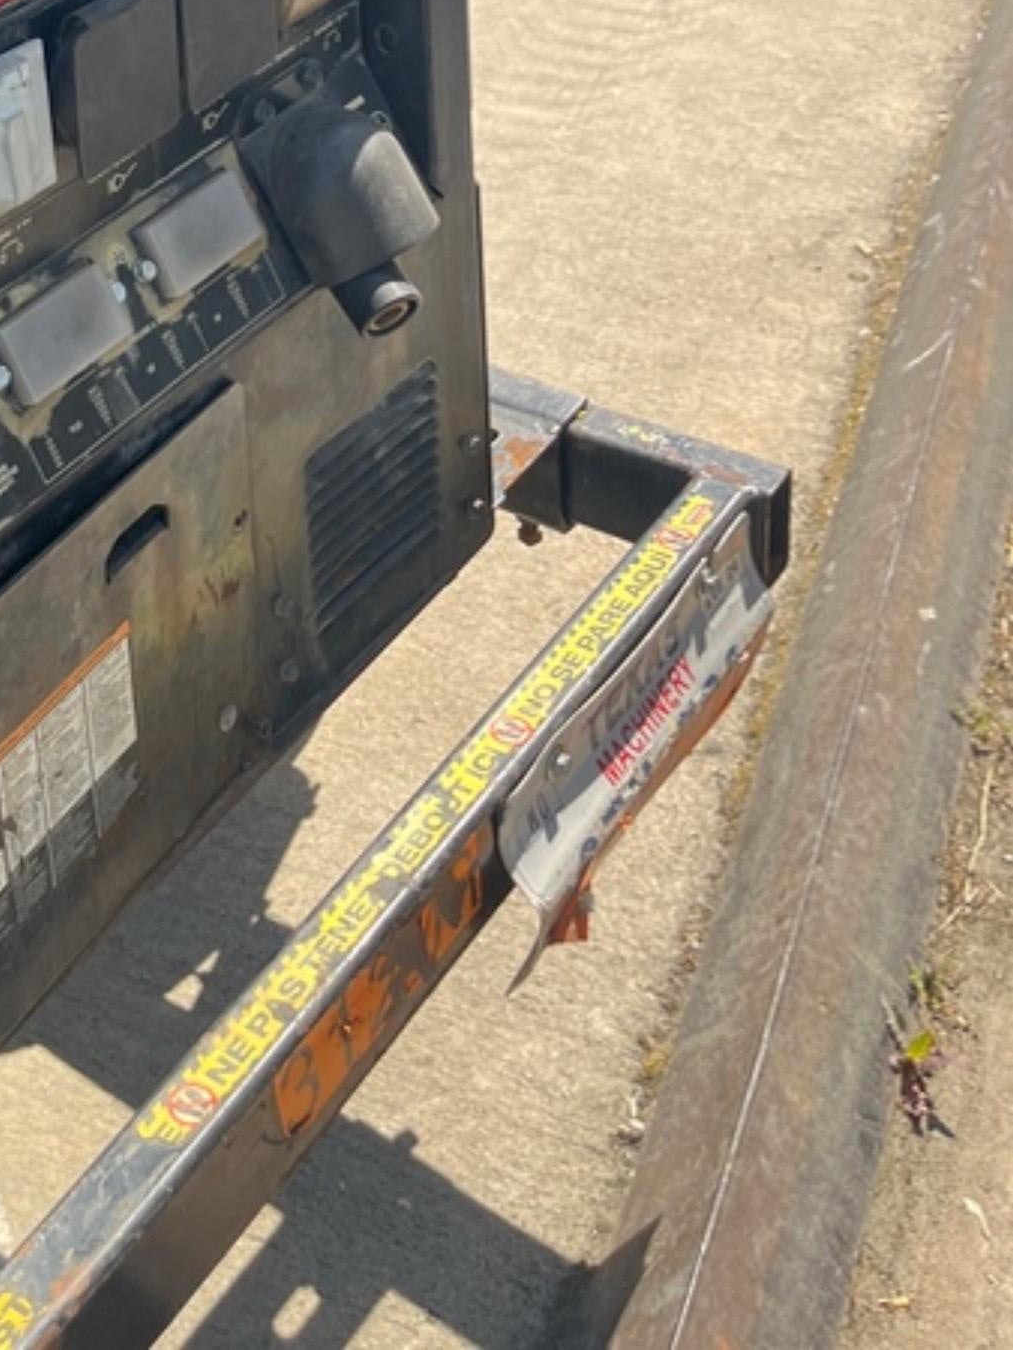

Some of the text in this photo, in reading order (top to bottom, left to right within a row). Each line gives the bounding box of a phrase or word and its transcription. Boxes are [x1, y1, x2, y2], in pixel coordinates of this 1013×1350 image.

[206, 1033, 255, 1086] NE
[551, 647, 585, 681] SE
[579, 597, 629, 654] PARE
[595, 653, 697, 787] MACHINERY
